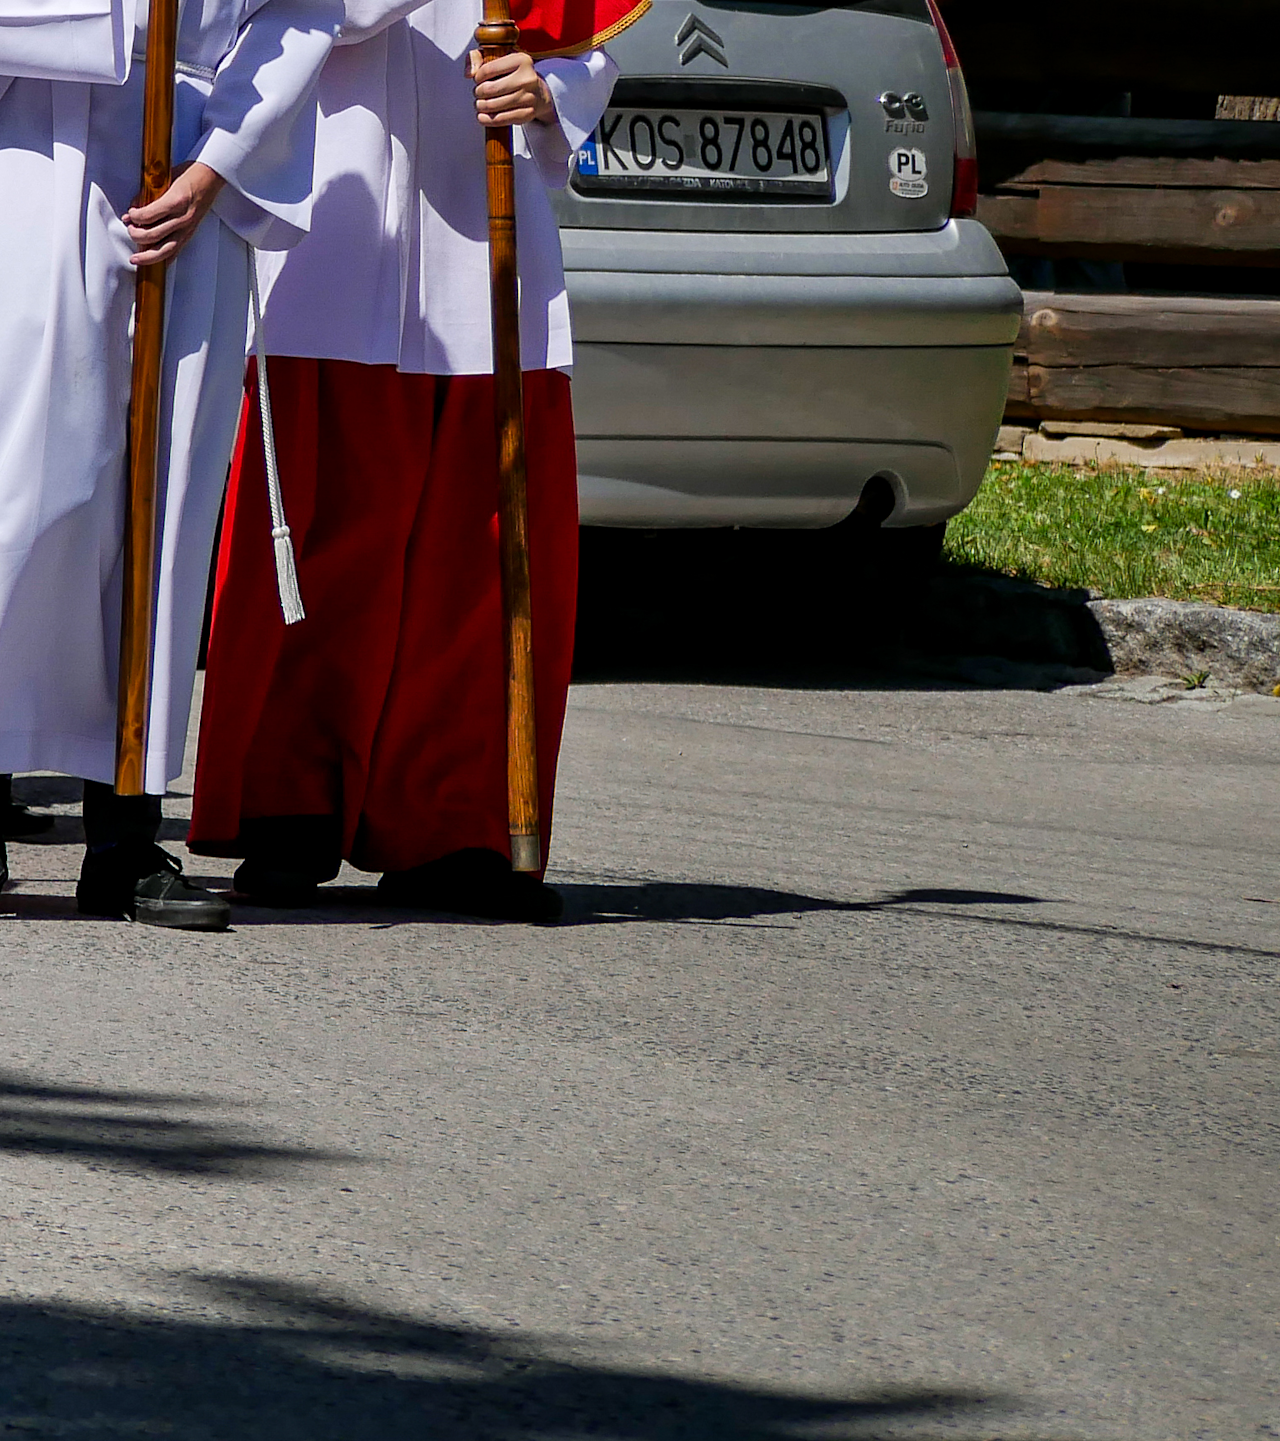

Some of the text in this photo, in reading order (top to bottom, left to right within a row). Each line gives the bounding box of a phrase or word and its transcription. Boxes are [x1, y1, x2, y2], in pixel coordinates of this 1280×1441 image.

[578, 113, 822, 175] PL KOS 87848
[897, 152, 922, 175] PL
